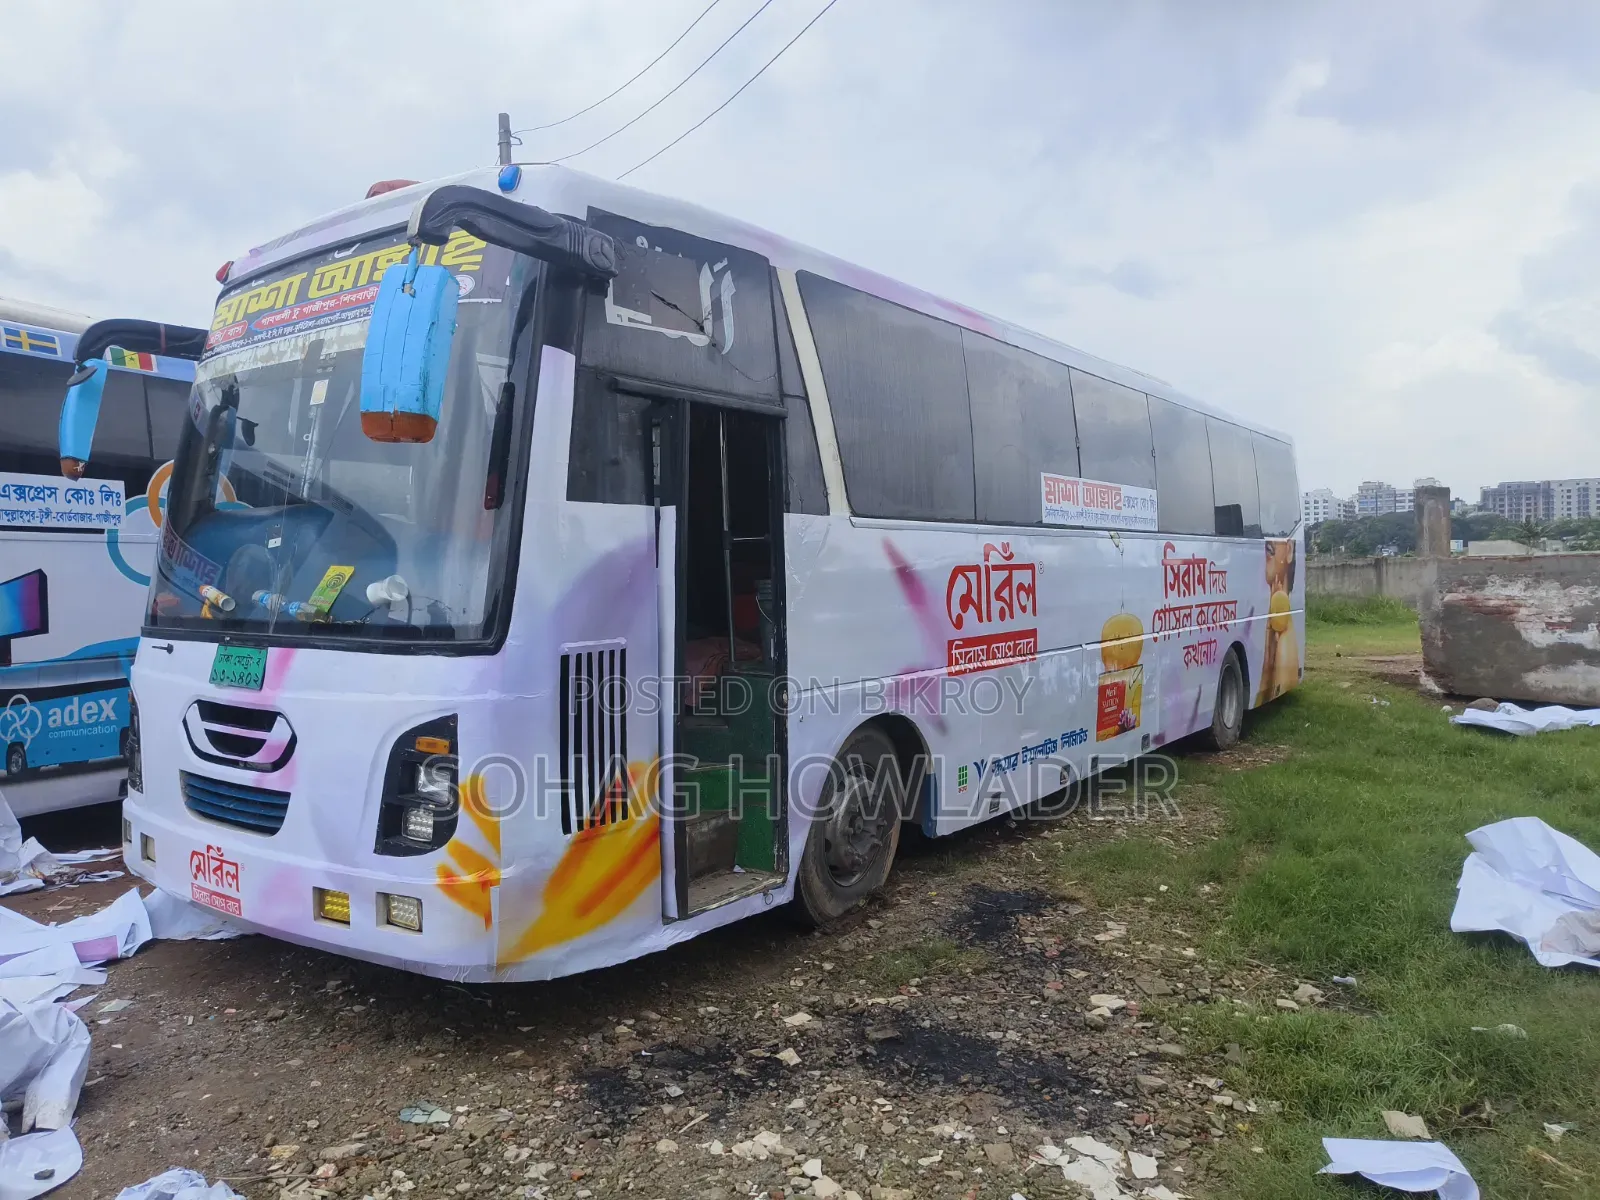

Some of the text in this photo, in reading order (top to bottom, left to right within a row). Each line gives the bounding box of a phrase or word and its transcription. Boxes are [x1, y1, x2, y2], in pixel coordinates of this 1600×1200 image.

[211, 272, 308, 331] মাশা
[228, 325, 244, 337] বাস
[0, 484, 122, 506] এক্সপ্রেস কোঃ লিঃ
[1044, 476, 1079, 506] মাশা
[1162, 541, 1227, 599] সিরাম দিয়ে
[1153, 600, 1238, 643] গোসল করেছেন
[219, 653, 234, 664] ঢাকা
[952, 638, 1035, 673] সিরাম সোপ বার
[1183, 638, 1217, 670] কখনো?
[48, 697, 118, 727] adex
[49, 725, 118, 739] communication
[1060, 728, 1089, 750] লিমিটেড
[193, 884, 240, 915] সিরাম সোপ বার
